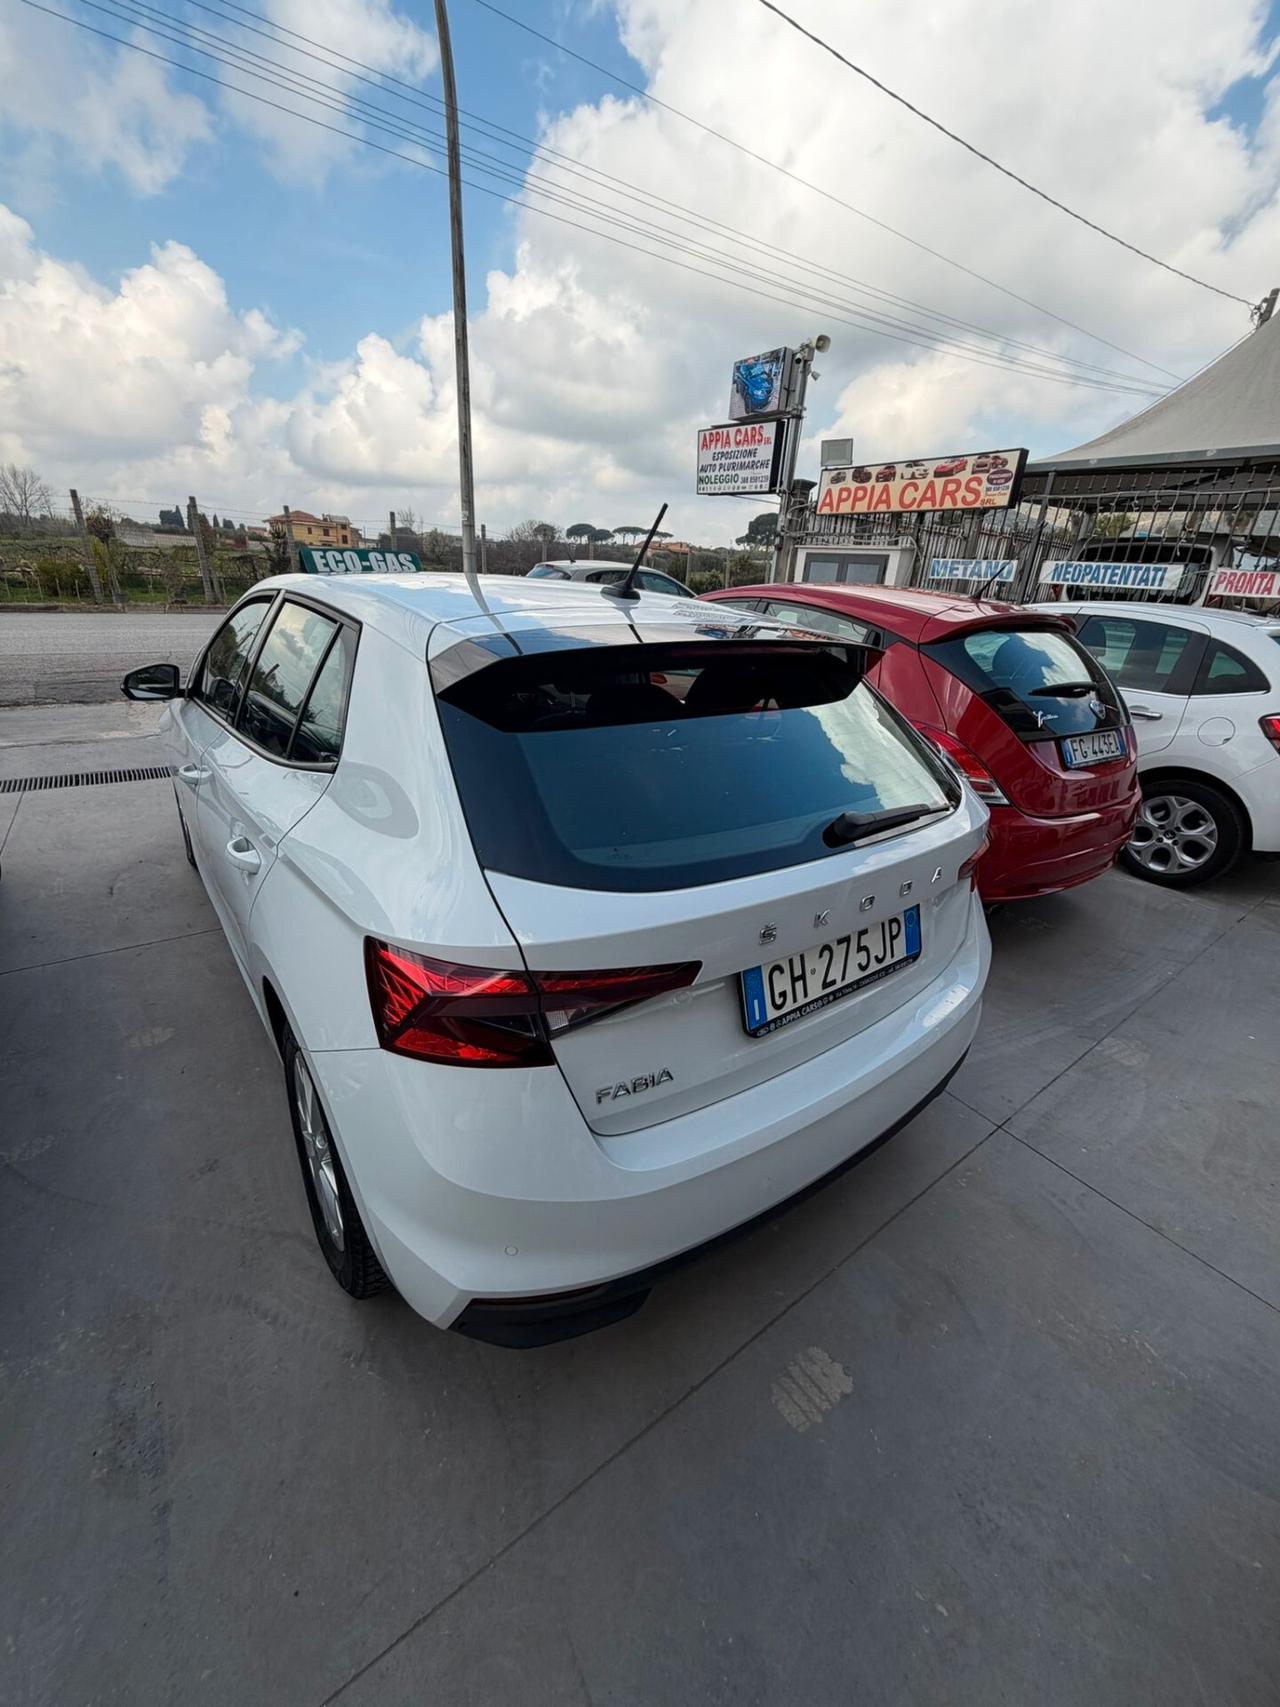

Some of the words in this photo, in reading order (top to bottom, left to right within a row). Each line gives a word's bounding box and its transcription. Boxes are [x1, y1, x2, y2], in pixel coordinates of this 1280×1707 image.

[701, 430, 731, 451] APPIA
[734, 425, 764, 448] CARS
[700, 463, 717, 473] AUTO
[718, 459, 770, 472] PLURIMARCHE
[712, 448, 758, 461] ESPOSIZIONE
[699, 473, 739, 485] NOLEGGIO
[818, 483, 891, 513] APPIA
[898, 475, 983, 510] CARS
[312, 550, 417, 573] ECO-GAS
[929, 559, 1014, 580] METANO
[1051, 562, 1168, 588] NEOPATENTATI
[1214, 571, 1276, 596] PRONTA
[1071, 738, 1088, 761] FG
[768, 953, 809, 1011] GH
[818, 916, 902, 991] 275JP
[595, 1067, 674, 1105] FABIA
